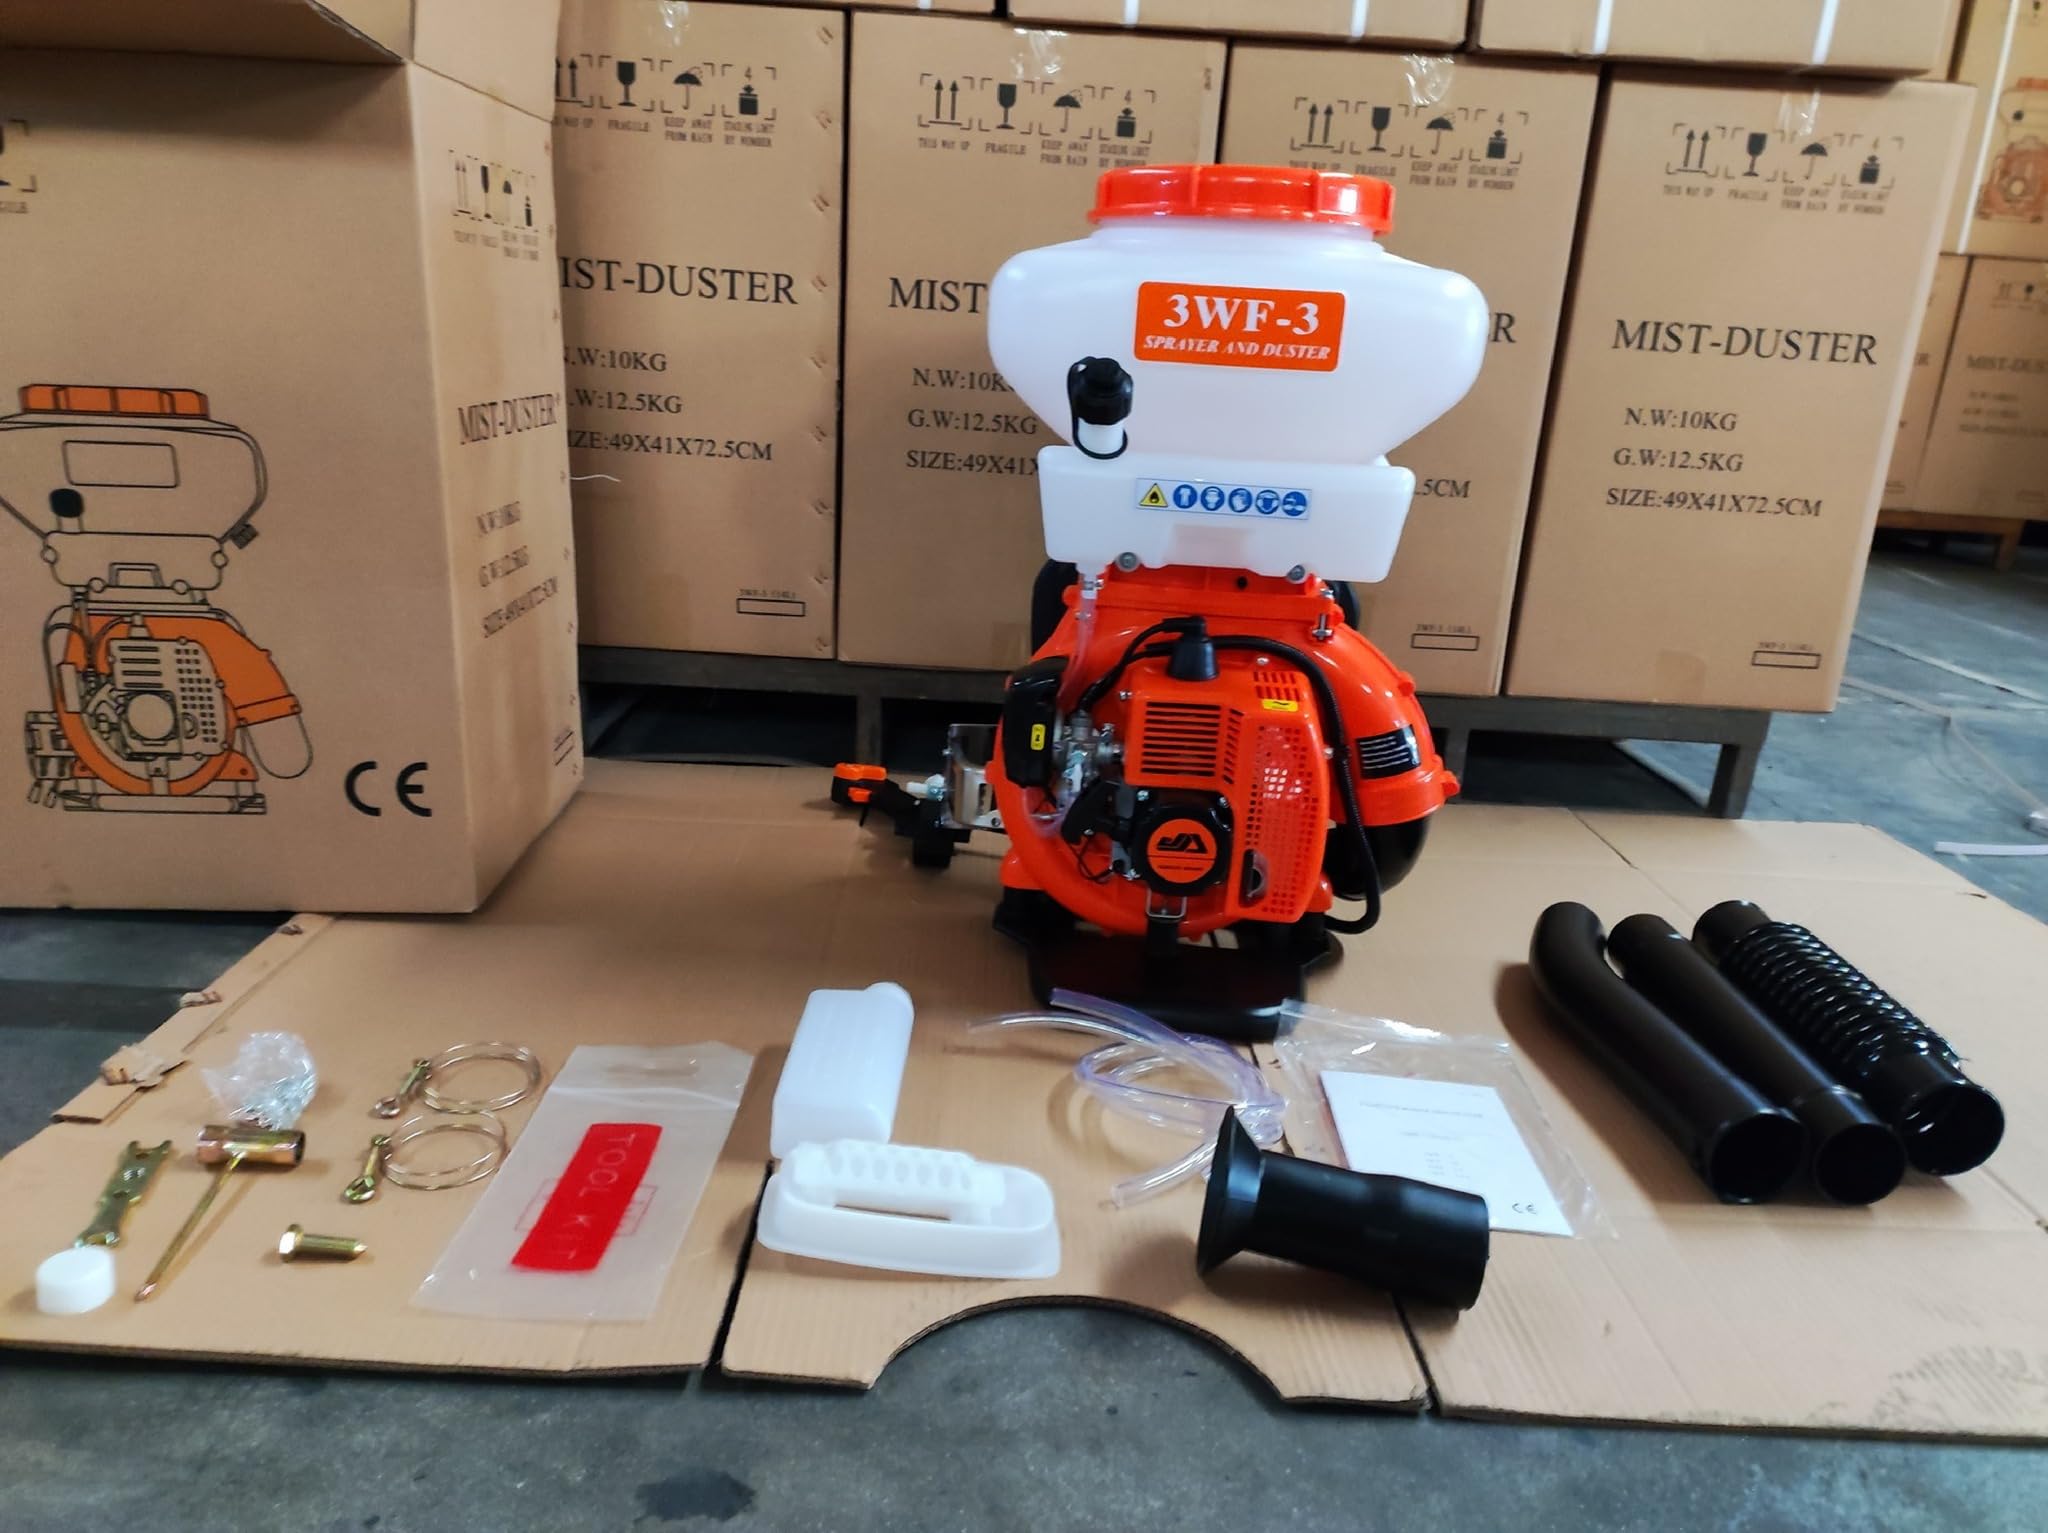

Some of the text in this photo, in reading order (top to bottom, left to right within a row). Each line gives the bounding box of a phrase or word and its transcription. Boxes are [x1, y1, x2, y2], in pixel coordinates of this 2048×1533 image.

[985, 142, 1026, 155] FRAGILE
[560, 256, 799, 305] IST-DUSTER
[888, 277, 988, 314] MIST
[1163, 294, 1320, 336] 3WF-3
[1489, 312, 1517, 343] R
[1144, 335, 1331, 360] SPRAYER AND DUSTER
[1612, 319, 1878, 365] MIST-DUSTER
[912, 368, 1014, 392] N.W:10K
[457, 394, 556, 445] MIST-DUSTER
[907, 408, 1038, 435] G.W:12.5KG
[1624, 407, 1738, 431] N.W:10KG
[1613, 448, 1744, 472] G.W:12.5KG
[1606, 487, 1823, 517] SIZE:49X41X72.5CM
[344, 760, 432, 817] CE
[578, 1132, 637, 1198] TOOL
